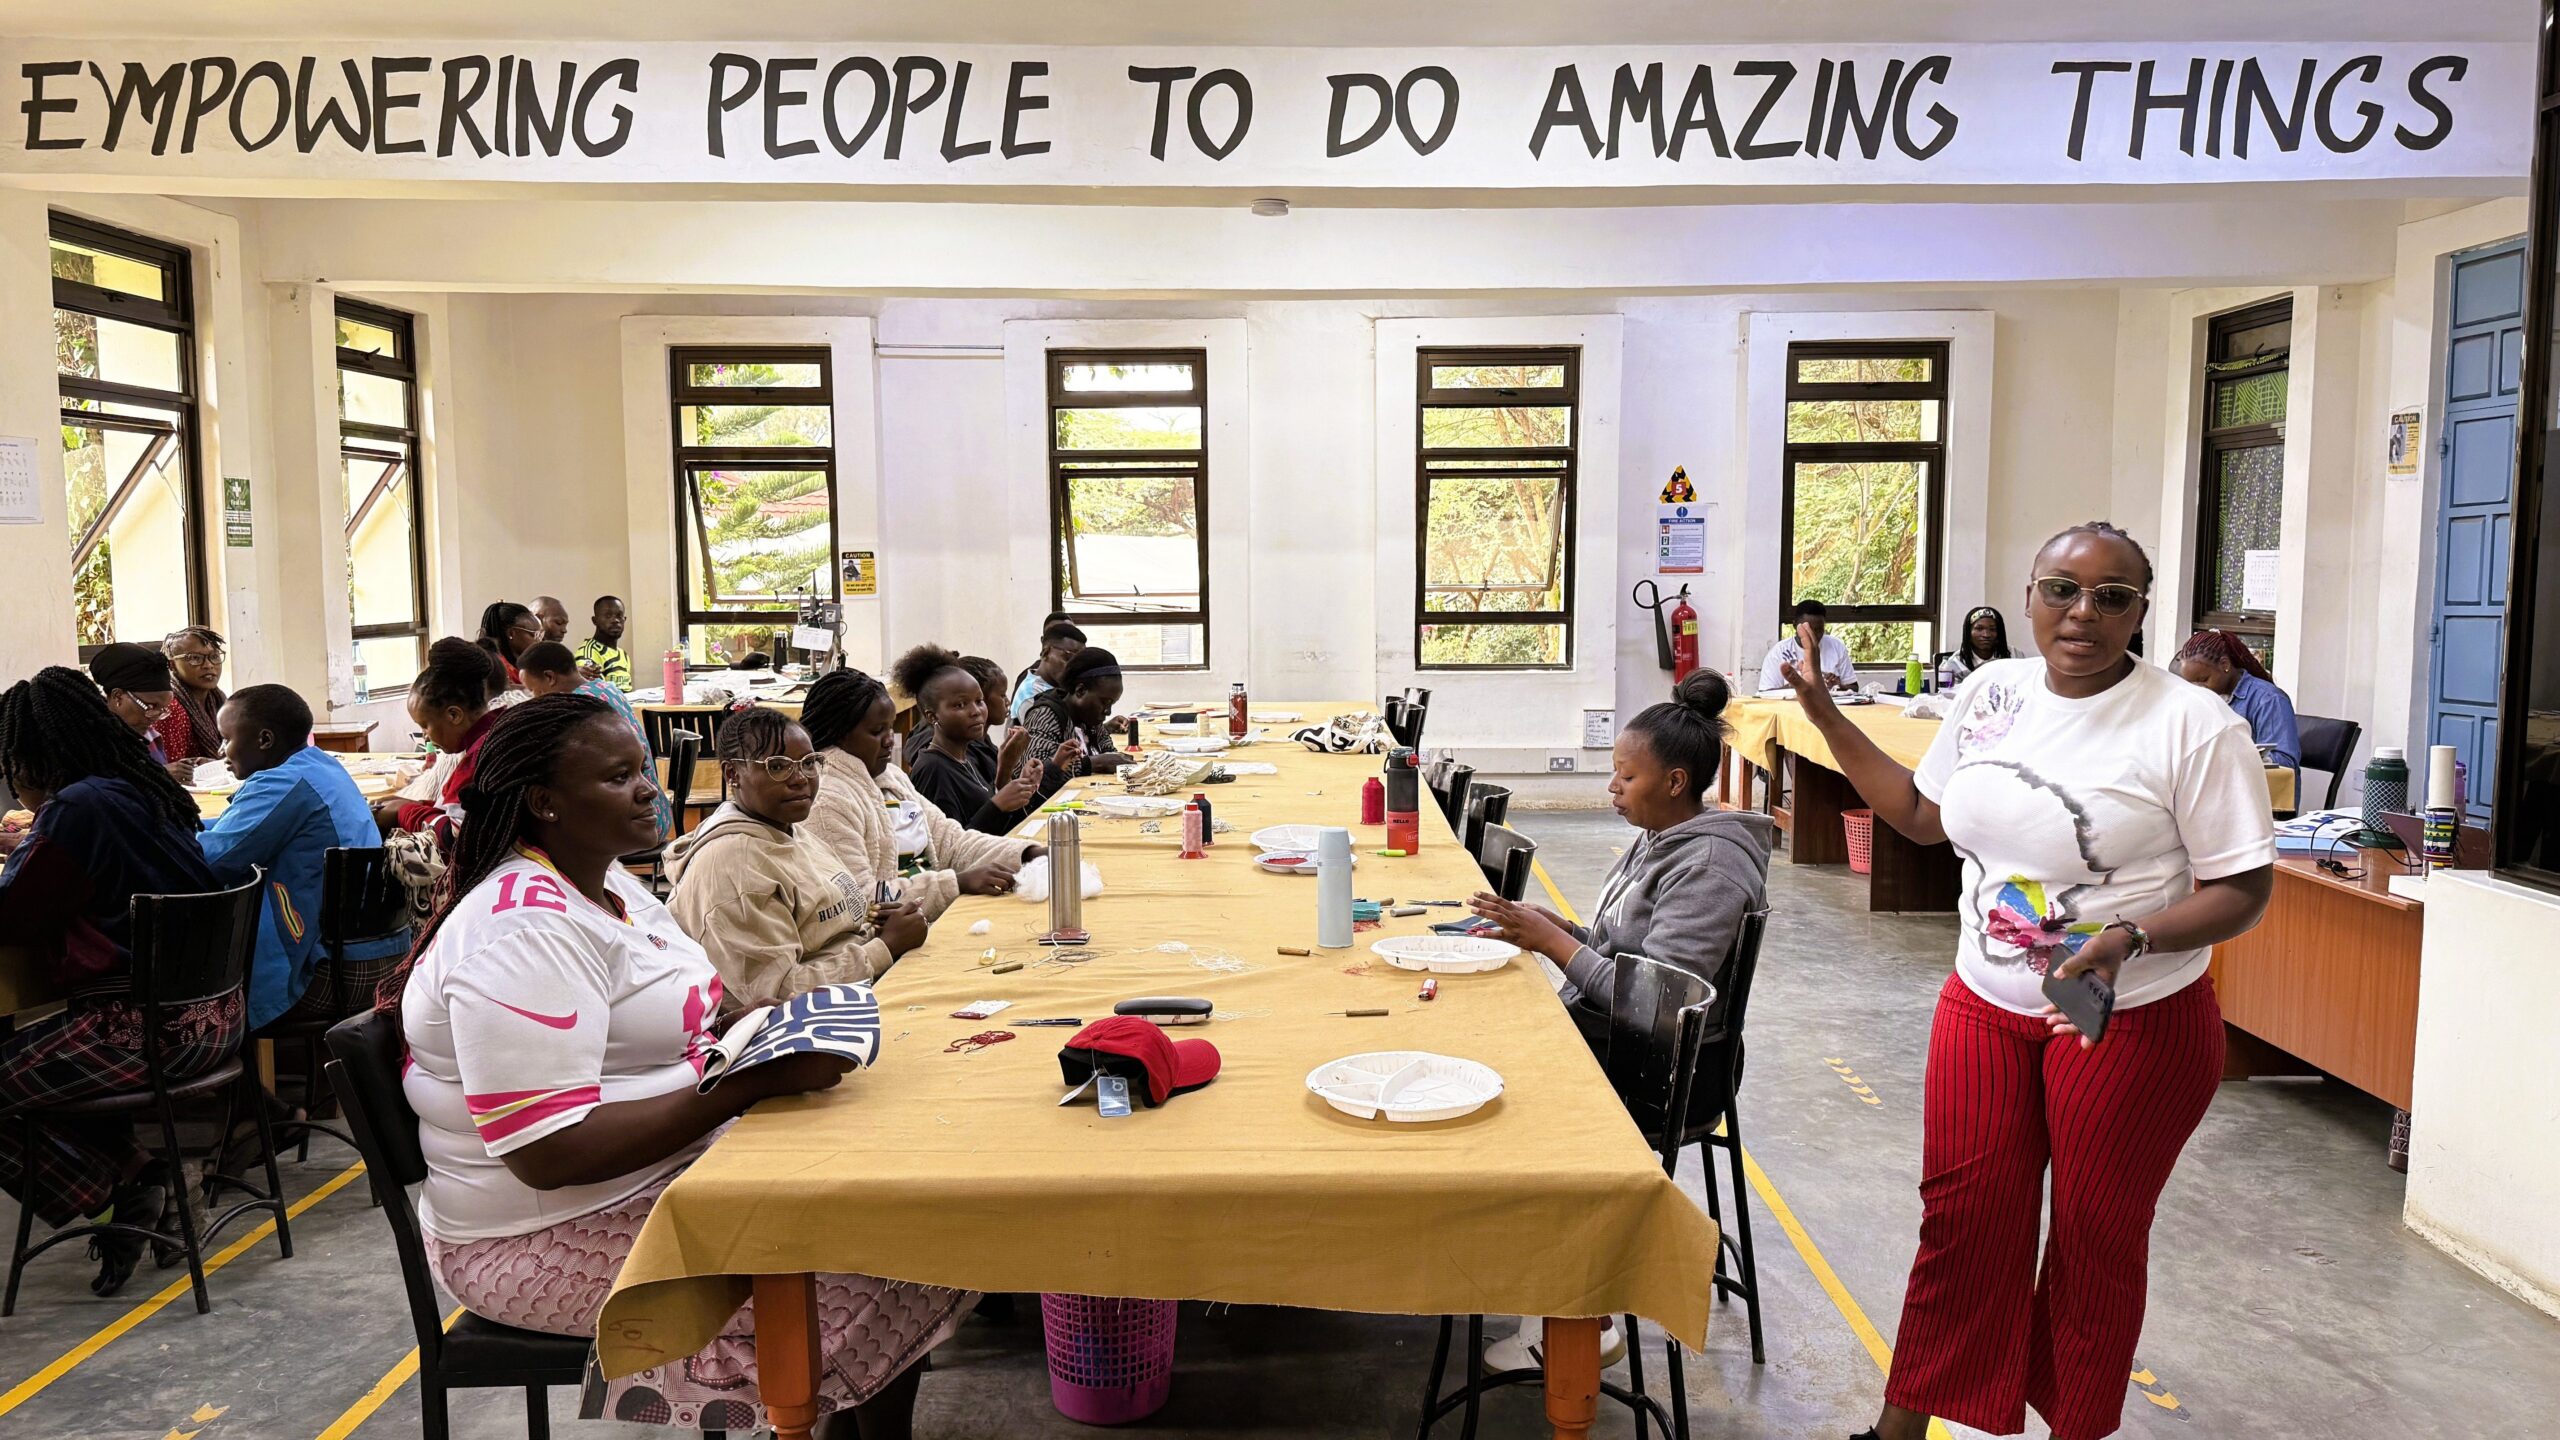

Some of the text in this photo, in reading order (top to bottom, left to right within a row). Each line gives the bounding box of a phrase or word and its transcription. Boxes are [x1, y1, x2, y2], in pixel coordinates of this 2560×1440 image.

[708, 53, 1051, 162] PEOPLE
[1128, 66, 1252, 161] TO
[1327, 66, 1459, 157] DO
[1529, 56, 1958, 162] AMAZING
[2051, 56, 2468, 161] THINGS
[1675, 484, 1683, 493] 5
[492, 872, 567, 915] 12
